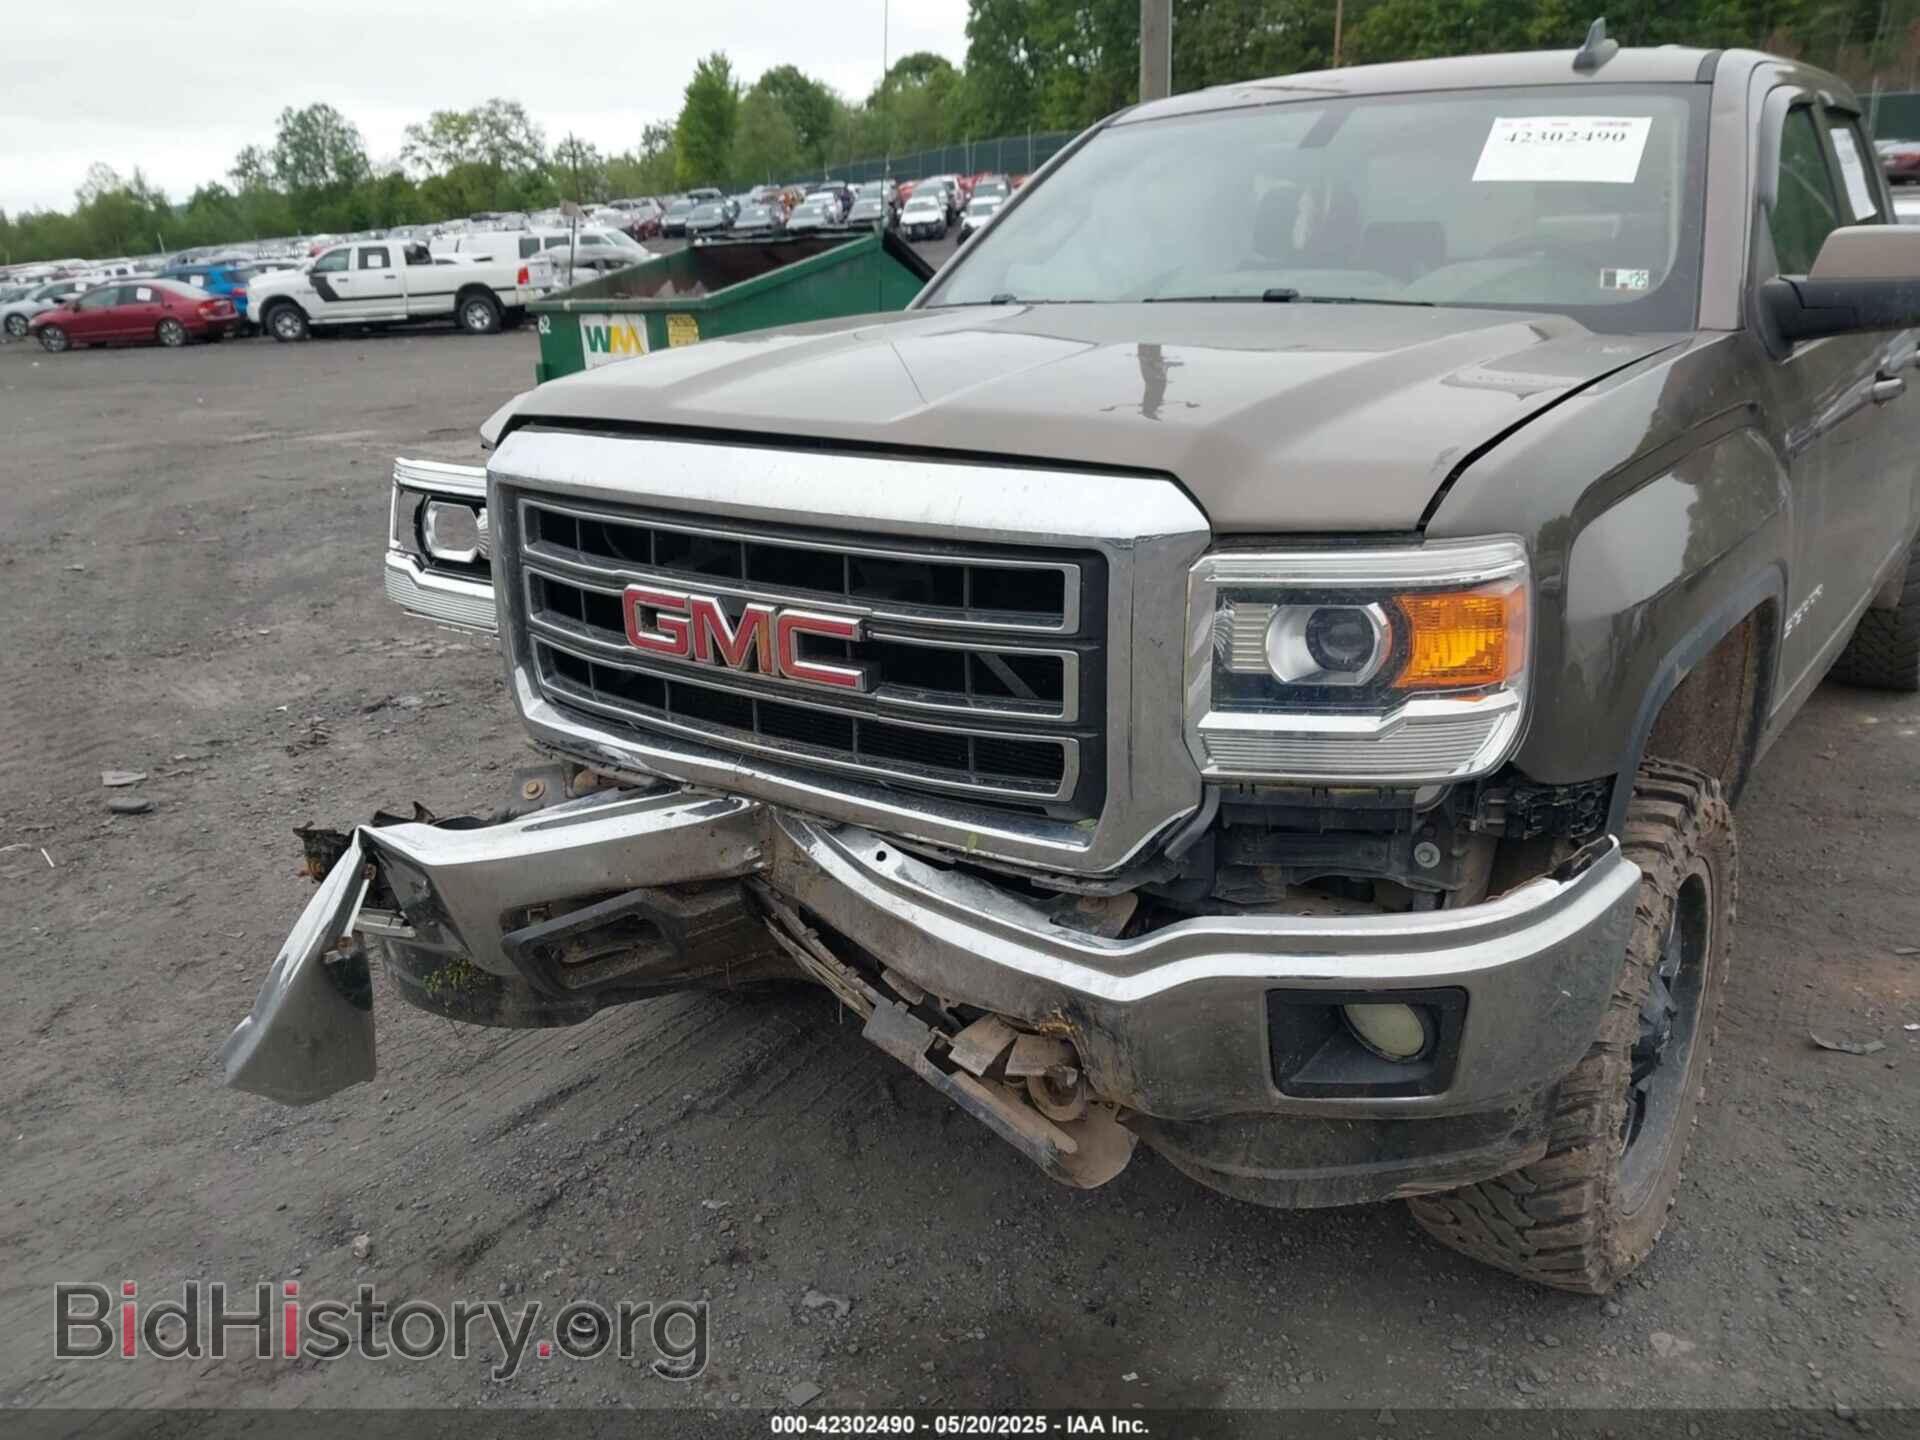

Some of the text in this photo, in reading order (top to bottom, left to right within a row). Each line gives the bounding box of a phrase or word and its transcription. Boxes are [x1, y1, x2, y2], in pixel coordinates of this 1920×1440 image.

[1503, 130, 1627, 143] 42302490
[584, 324, 646, 354] WM
[622, 583, 868, 692] GMC
